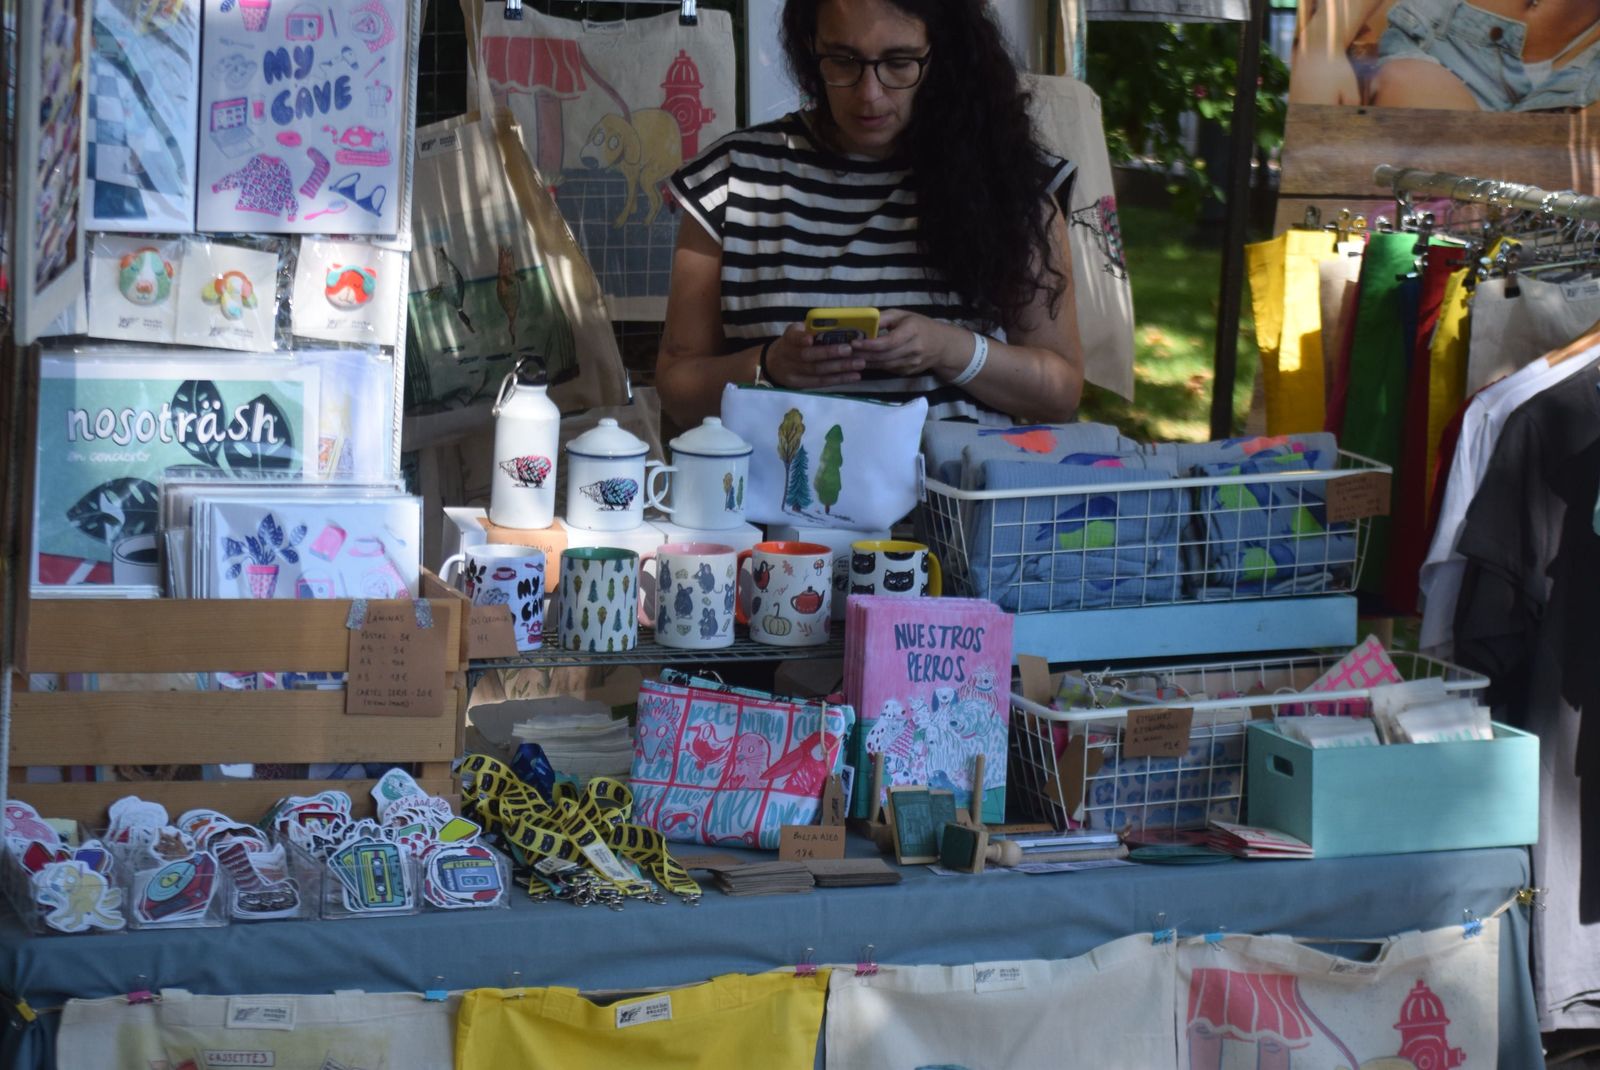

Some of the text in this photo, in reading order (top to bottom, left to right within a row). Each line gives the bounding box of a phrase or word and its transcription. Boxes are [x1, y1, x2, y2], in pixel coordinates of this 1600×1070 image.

[263, 45, 315, 85] MY
[271, 75, 352, 125] CAVE
[66, 399, 278, 446] nosoträsh
[517, 576, 540, 600] MY
[894, 623, 986, 653] NUESTROS
[907, 651, 966, 683] PERROS
